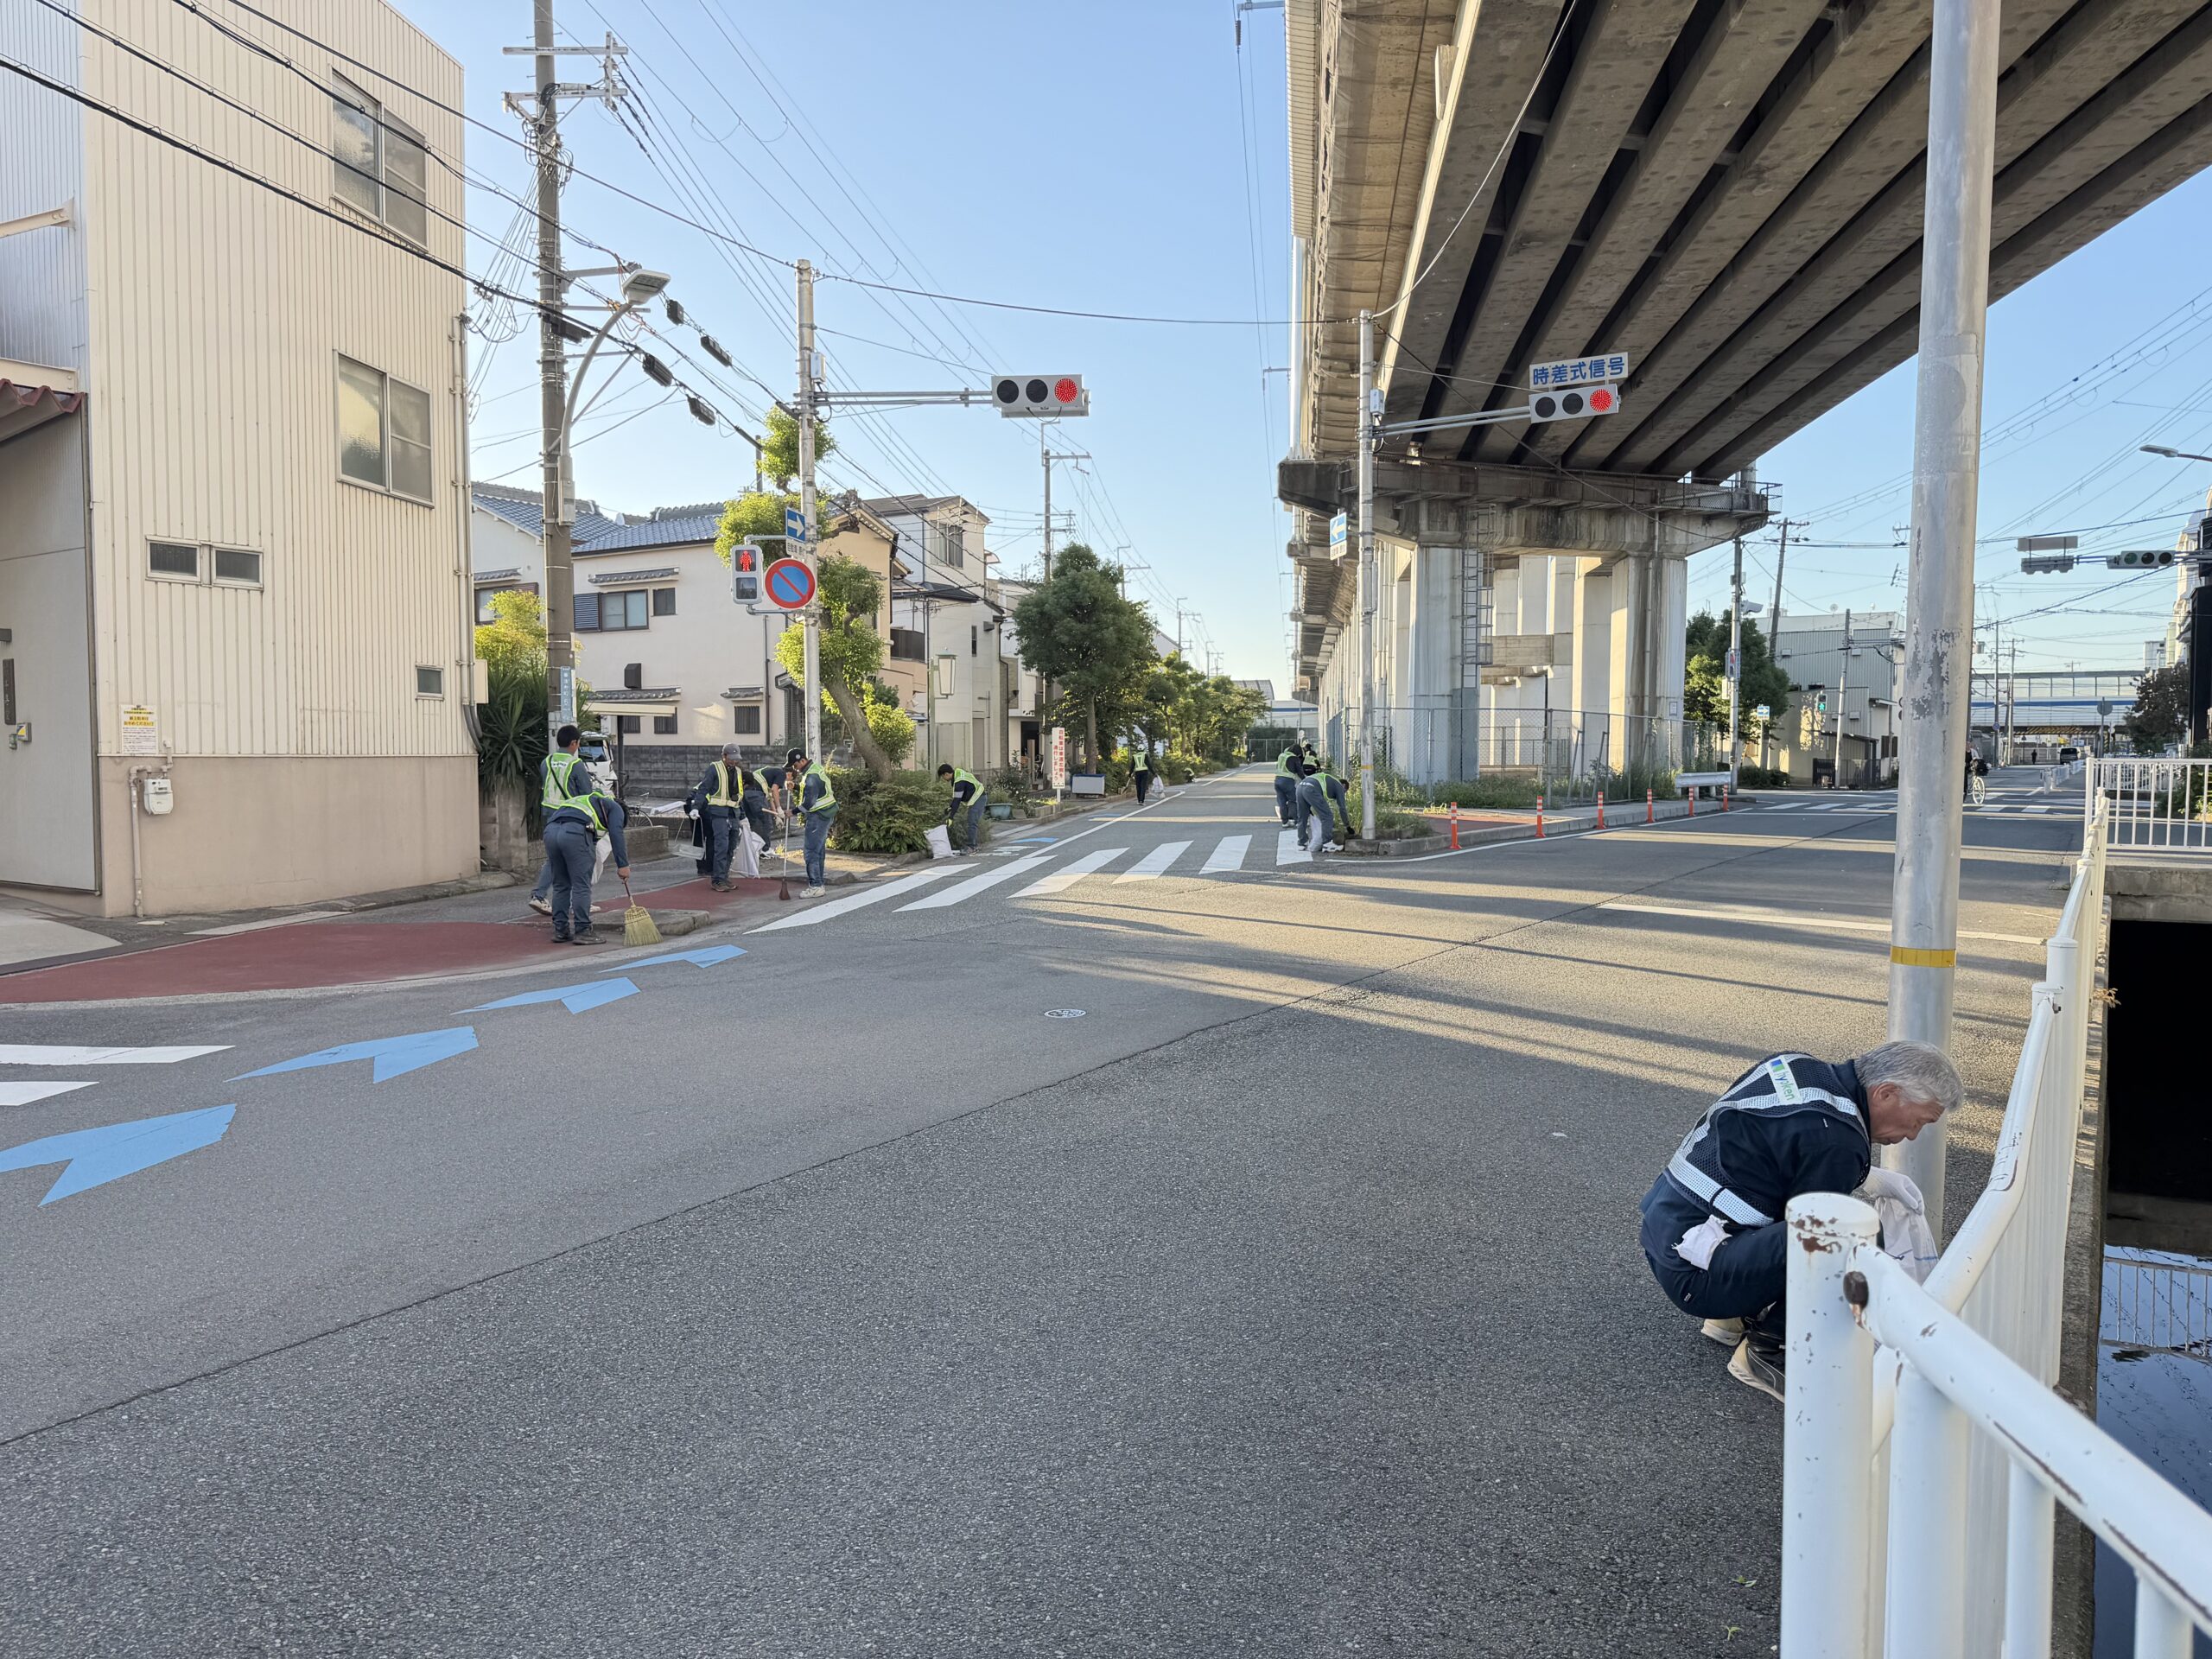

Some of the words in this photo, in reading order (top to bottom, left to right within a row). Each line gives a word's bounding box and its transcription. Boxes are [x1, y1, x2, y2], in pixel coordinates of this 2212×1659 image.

[1533, 356, 1625, 385] 時差式信号
